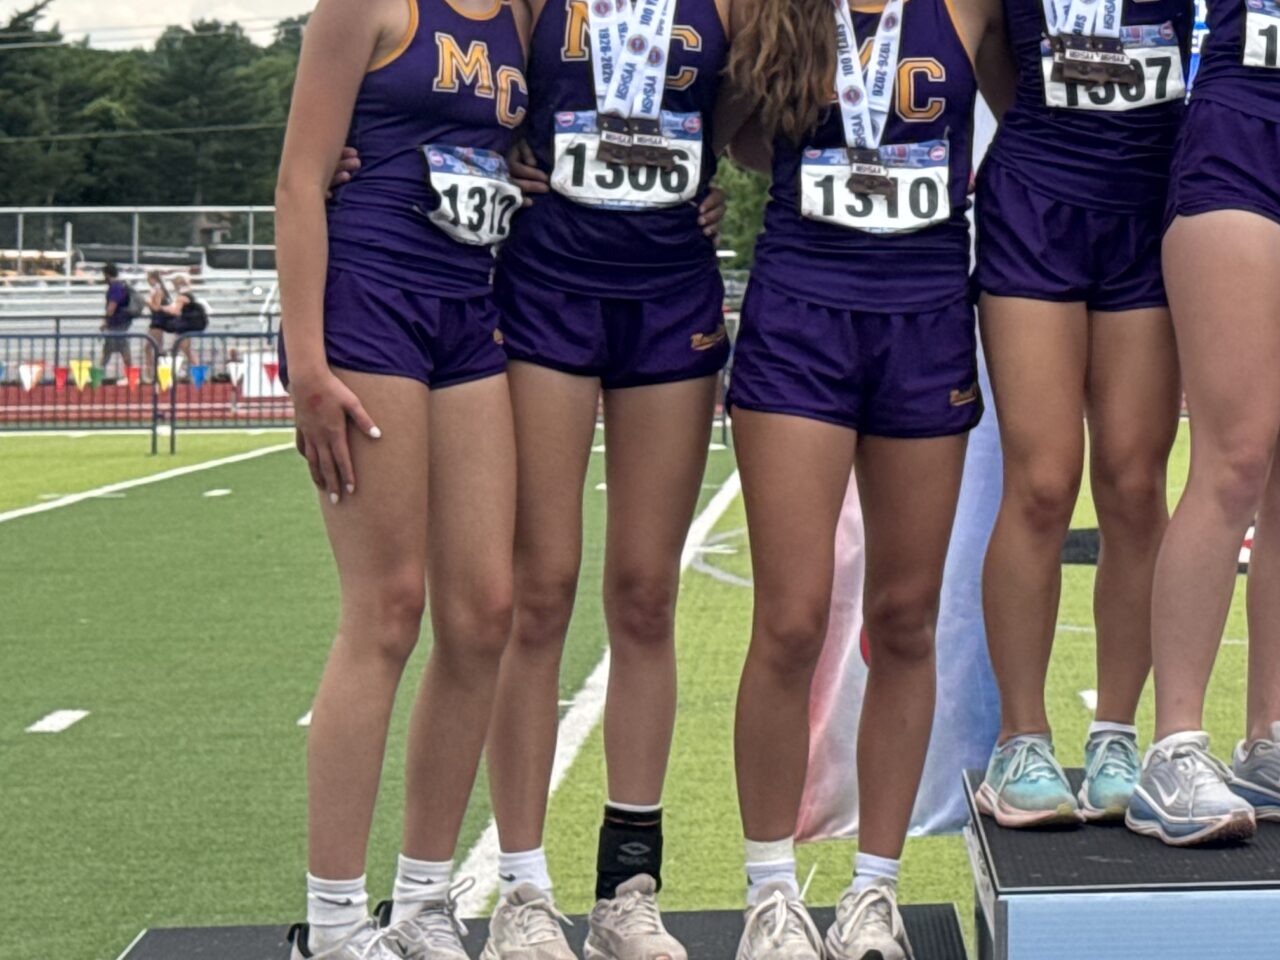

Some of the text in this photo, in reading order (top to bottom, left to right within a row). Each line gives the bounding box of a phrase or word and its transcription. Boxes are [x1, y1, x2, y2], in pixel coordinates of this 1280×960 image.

[432, 31, 529, 129] MC
[565, 142, 690, 194] 1306
[813, 174, 939, 219] 1310
